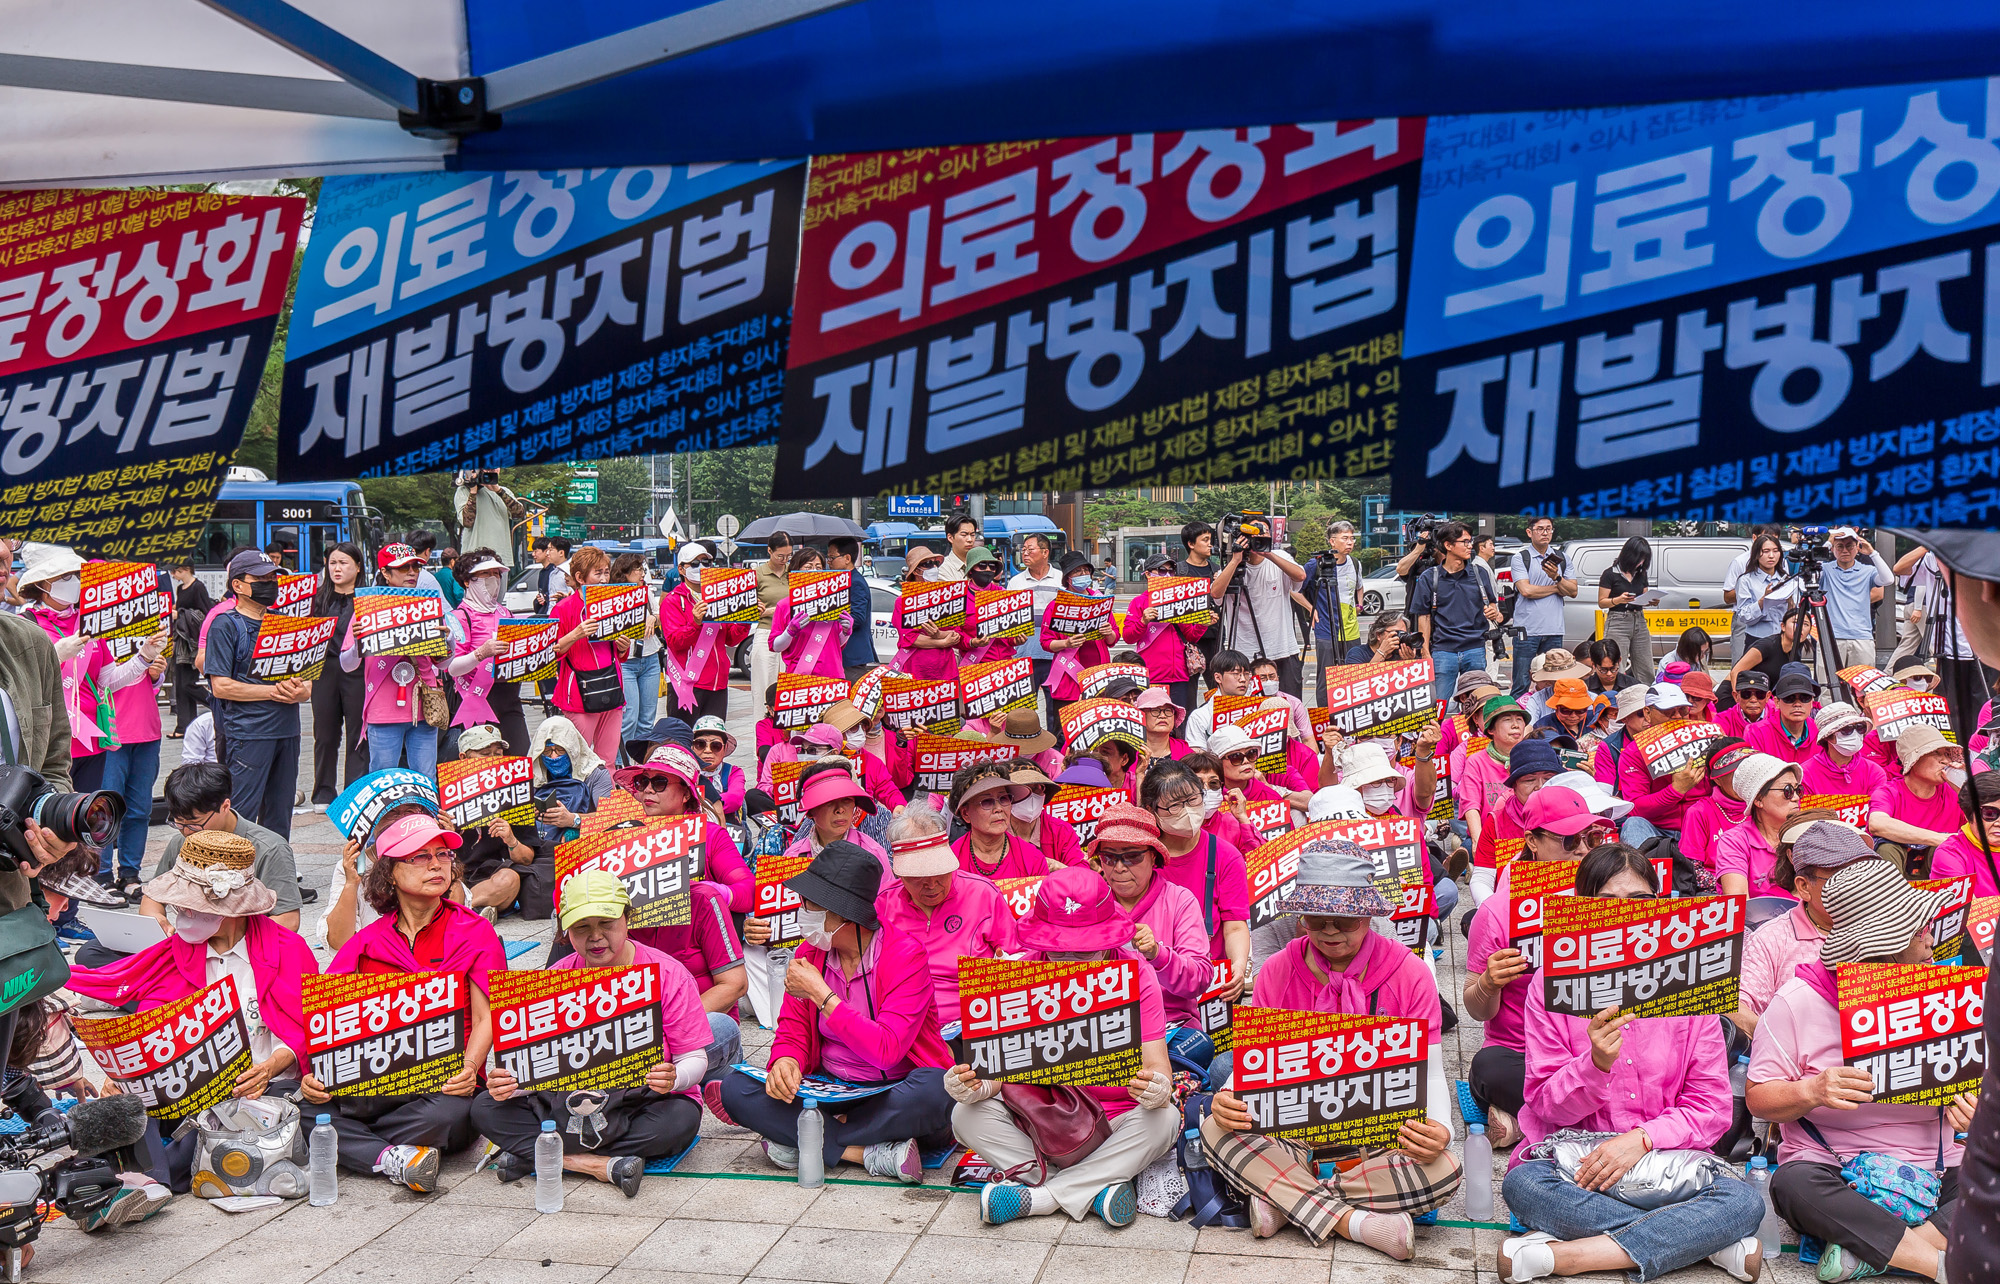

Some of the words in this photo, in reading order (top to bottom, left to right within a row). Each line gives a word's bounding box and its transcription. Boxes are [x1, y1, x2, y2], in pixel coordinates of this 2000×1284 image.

[1588, 119, 1638, 151] 의사
[937, 148, 981, 181] 의사
[52, 205, 79, 229] 철회
[83, 204, 97, 222] 및
[99, 194, 127, 216] 재발
[14, 236, 68, 266] 집단휴진
[72, 225, 100, 249] 철회
[102, 222, 116, 241] 및
[118, 212, 148, 235] 재발
[149, 199, 192, 228] 방지법
[313, 159, 776, 328] 의료정
[299, 189, 775, 459] 재발방지법
[803, 185, 1398, 475] 재발방지법
[0, 335, 250, 475] 방지법
[394, 434, 460, 476] 집단휴진
[463, 419, 498, 453] 철회
[500, 411, 519, 437] 및
[521, 396, 557, 426] 재발
[560, 374, 614, 416] 방지법
[616, 358, 655, 391] 제정
[657, 314, 768, 377] 환자촉구대회
[521, 419, 573, 462] 방지법
[575, 405, 613, 437] 제정
[615, 362, 724, 424] 환자촉구대회
[741, 340, 780, 373] 의사
[703, 386, 743, 419] 의사
[925, 453, 1011, 496] 집단휴진
[1015, 437, 1059, 475] 철회
[1064, 429, 1087, 458] 및
[1092, 414, 1138, 448] 재발
[1142, 392, 1210, 436] 방지법
[1212, 376, 1262, 412] 제정
[1265, 329, 1404, 397] 환자촉구대회
[1090, 441, 1157, 485] 방지법
[1161, 426, 1209, 462] 제정
[1213, 381, 1350, 449] 환자촉구대회
[1327, 408, 1377, 445] 의사
[2, 481, 34, 504] 재발
[36, 474, 84, 500] 방지법
[82, 468, 118, 492] 제정
[118, 451, 216, 488] 환자촉구대회
[1688, 460, 1744, 500] 철회
[1750, 452, 1780, 488] 및
[1784, 440, 1845, 476] 재발
[1848, 420, 1936, 466] 방지법
[36, 502, 72, 523] 제정
[71, 486, 169, 518] 환자촉구대회
[181, 476, 217, 498] 의사
[1782, 473, 1869, 519] 방지법
[1874, 459, 1936, 496] 제정
[136, 509, 173, 531] 의사
[283, 508, 312, 519] 3001
[102, 534, 141, 557] 의사
[84, 566, 157, 609] 의료정상화
[589, 587, 647, 621] 의료정상화
[704, 573, 757, 600] 의료정상화
[706, 590, 757, 619] 재발방지법
[792, 573, 850, 603] 의료정상화
[792, 589, 850, 617] 재발방지법
[904, 582, 967, 612] 의료정상화
[1151, 579, 1209, 605] 의료정상화
[83, 590, 160, 635] 재발방지법
[360, 598, 439, 633] 의료정상화
[904, 600, 964, 628] 재발방지법
[977, 591, 1032, 621] 의료정상화
[978, 606, 1032, 638] 재발방지법
[1051, 611, 1109, 634] 재발방지법
[1055, 597, 1114, 619] 의료정상화
[1655, 618, 1675, 627] 선을
[1679, 618, 1730, 628] 넘지마시오
[258, 619, 336, 656] 의료정상화
[361, 622, 441, 653] 재발방지법
[252, 641, 328, 676] 재발방지법
[497, 643, 556, 680] 재발방지법
[779, 681, 850, 709] 의료정상화
[885, 681, 957, 711] 의료정상화
[964, 659, 1032, 700] 의료정상화
[1082, 665, 1148, 690] 의료정상화
[1332, 661, 1430, 709] 의료정상화
[888, 701, 956, 730] 재발방지법
[967, 677, 1033, 719] 재발방지법
[1334, 685, 1431, 734] 재발방지법
[1876, 696, 1949, 722] 의료정상화
[1066, 705, 1144, 739] 의료정상화
[1071, 718, 1144, 751] 재발방지법
[1645, 722, 1722, 757] 의료정상화
[445, 760, 530, 803] 의료정상화
[341, 773, 435, 830] 의료정상화
[352, 783, 437, 845] 재발방지법
[449, 780, 530, 827] 재발방지법
[1553, 898, 1739, 969] 의료정상화
[3, 968, 36, 1000] NIKE
[997, 981, 1009, 990] 의사
[1010, 977, 1034, 989] 집단휴진
[1035, 973, 1047, 984] 철회
[1048, 971, 1054, 980] 및
[1055, 969, 1068, 979] 재발
[1069, 965, 1088, 976] 방지법
[1553, 940, 1733, 1011] 재발방지법
[309, 974, 458, 1046] 의료정상화
[500, 966, 655, 1042] 의료정상화
[969, 963, 1133, 1031] 의료정상화
[95, 980, 233, 1076] 의료정상화
[501, 1009, 654, 1083] 재발방지법
[971, 1008, 1131, 1074] 재발방지법
[312, 1015, 455, 1088] 재발방지법
[1051, 1063, 1064, 1073] 재발
[1065, 1059, 1083, 1070] 방지법
[1084, 1056, 1097, 1066] 제정
[1098, 1049, 1135, 1064] 환자촉구대회
[1242, 1022, 1422, 1084] 의료정상화
[1243, 1067, 1418, 1129] 재발방지법
